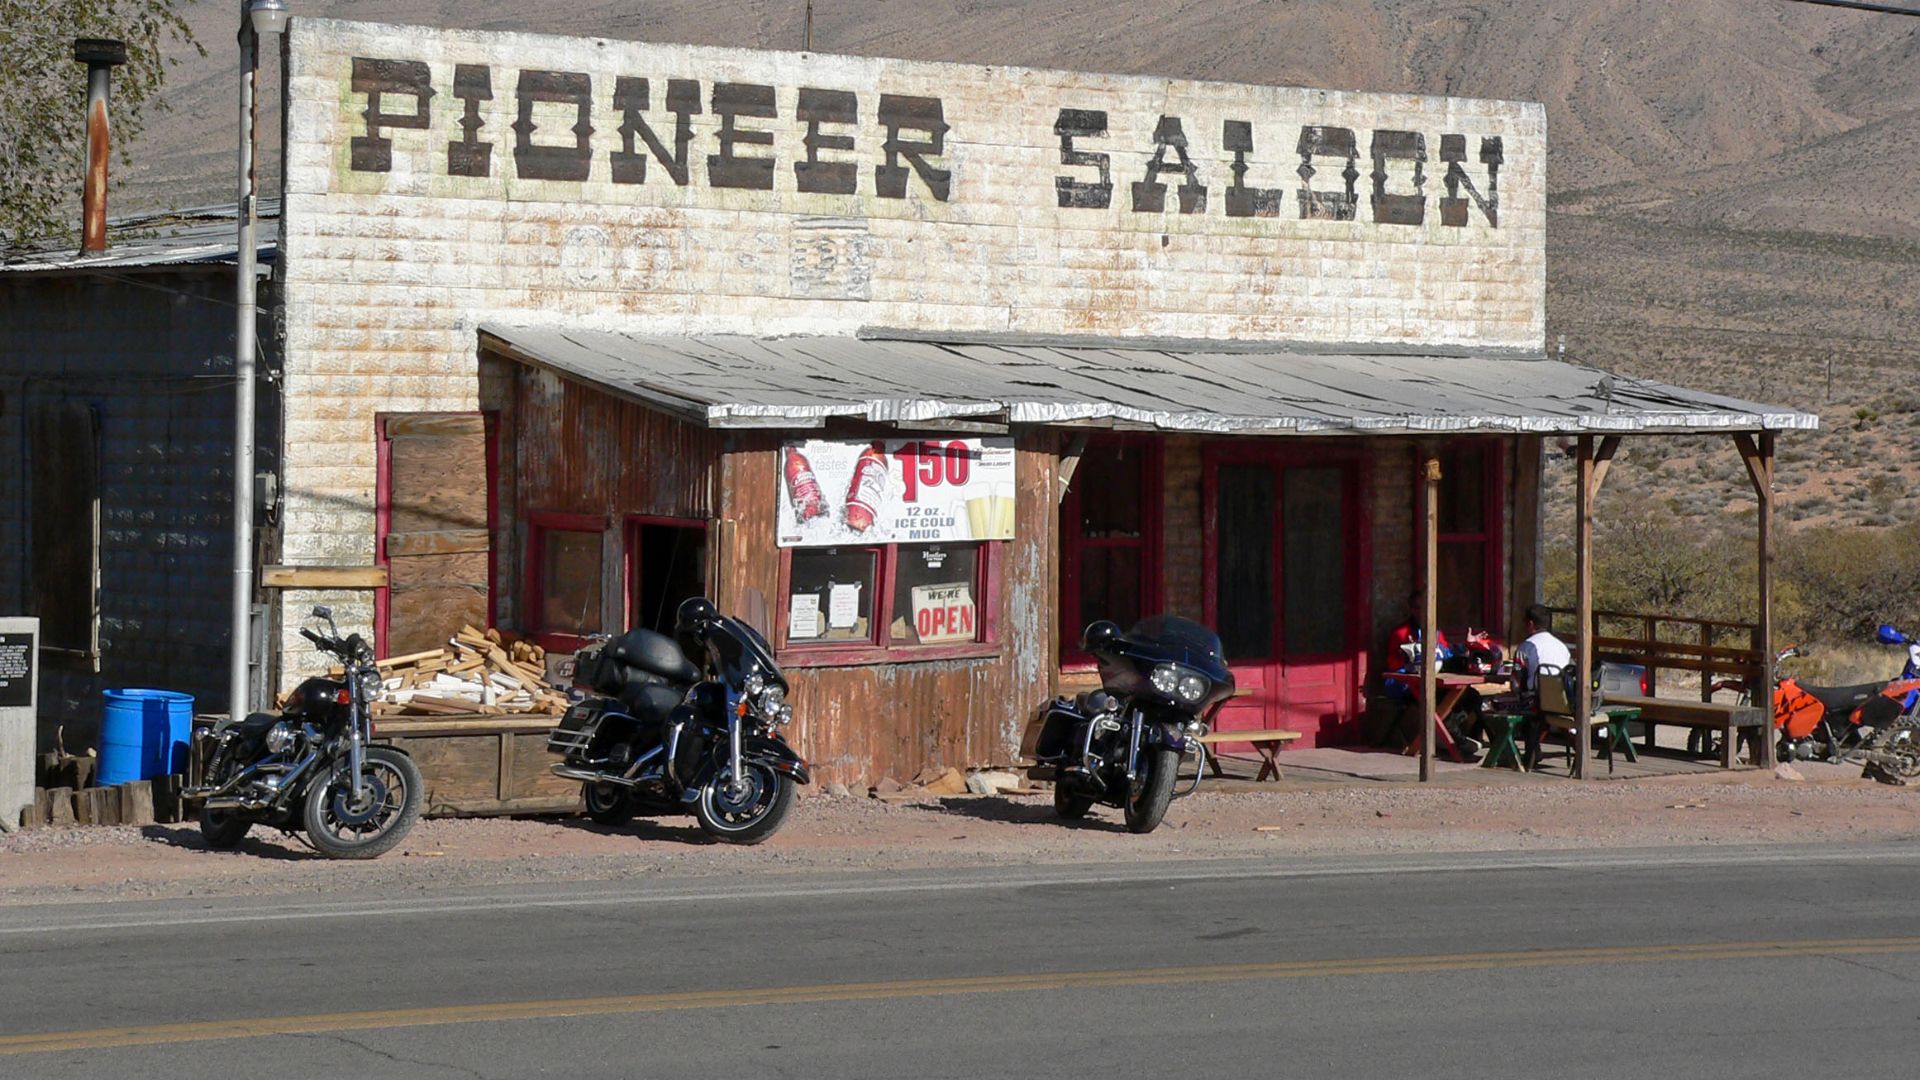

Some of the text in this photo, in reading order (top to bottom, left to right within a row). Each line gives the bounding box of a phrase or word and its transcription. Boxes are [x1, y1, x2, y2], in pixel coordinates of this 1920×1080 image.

[350, 57, 1504, 229] PIONEER SALOON
[815, 459, 848, 470] tastes
[906, 506, 921, 517] 12
[895, 517, 955, 529] ICE COLD
[909, 529, 940, 540] MUG
[928, 590, 960, 600] WE'RE
[918, 604, 973, 637] OPEN
